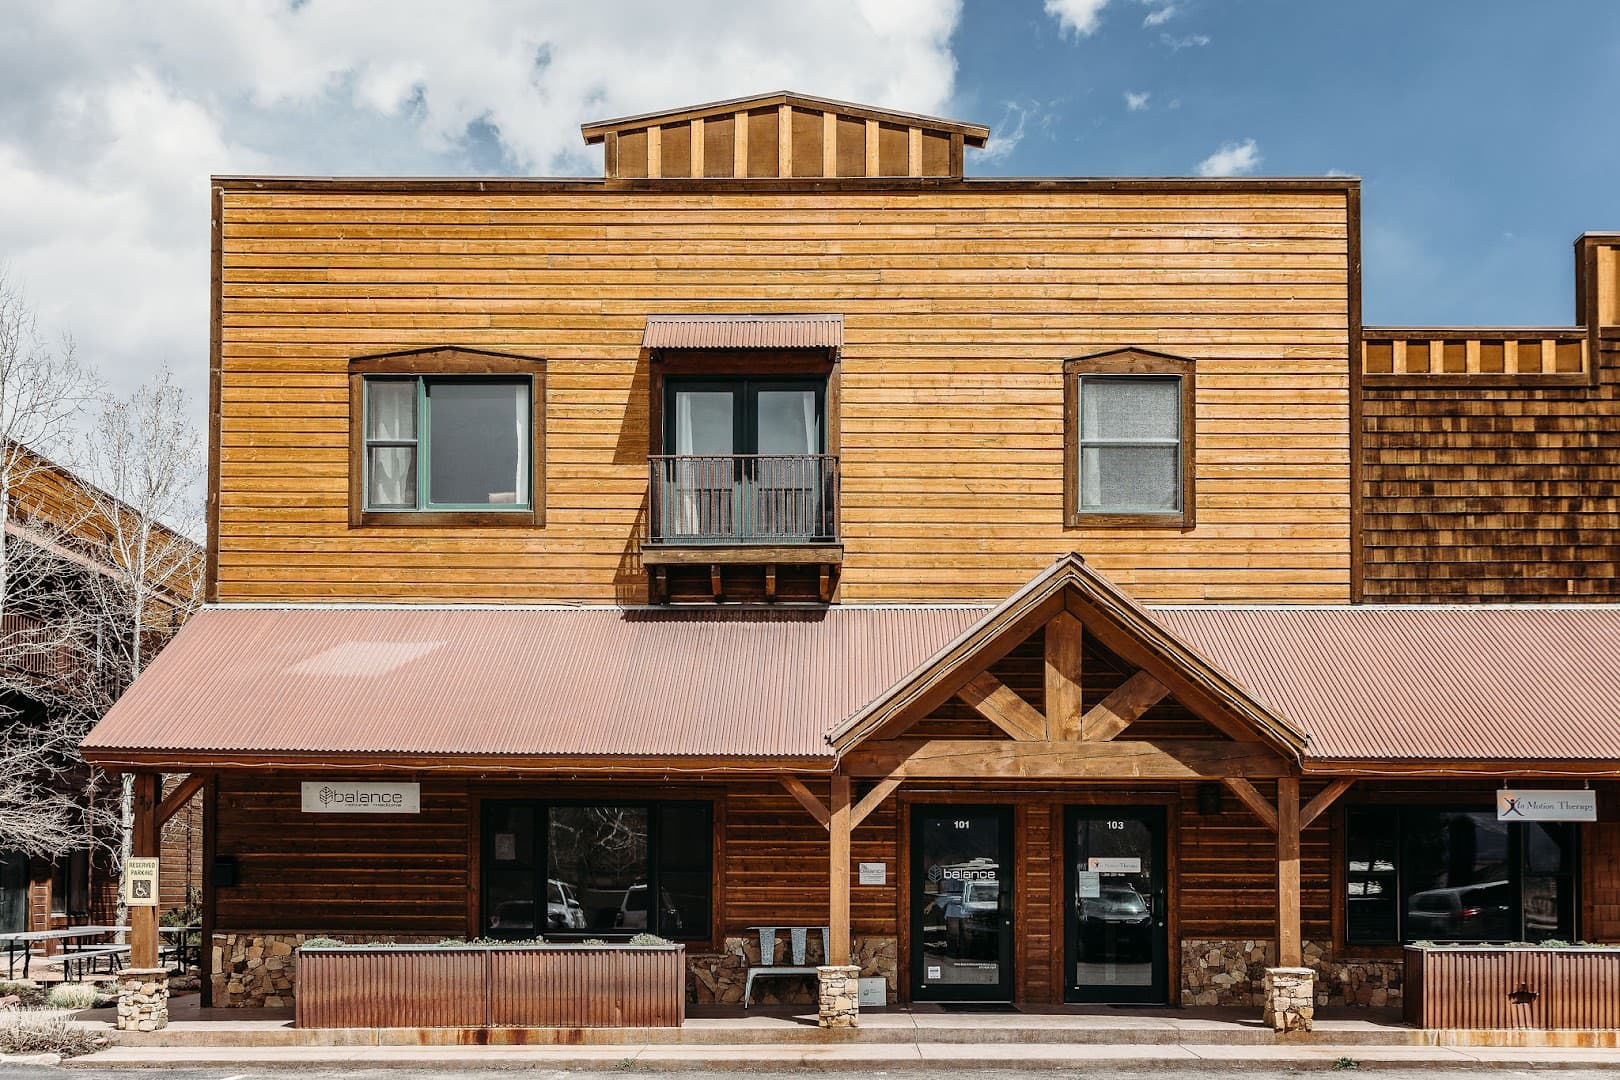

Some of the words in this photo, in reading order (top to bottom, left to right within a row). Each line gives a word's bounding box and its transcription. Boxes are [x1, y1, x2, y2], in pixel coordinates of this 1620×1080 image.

[333, 790, 403, 803] balance
[1527, 801, 1555, 809] Motion
[1559, 801, 1593, 811] Therapy
[954, 820, 970, 829] 101
[1106, 820, 1124, 830] 103
[943, 868, 996, 879] balance
